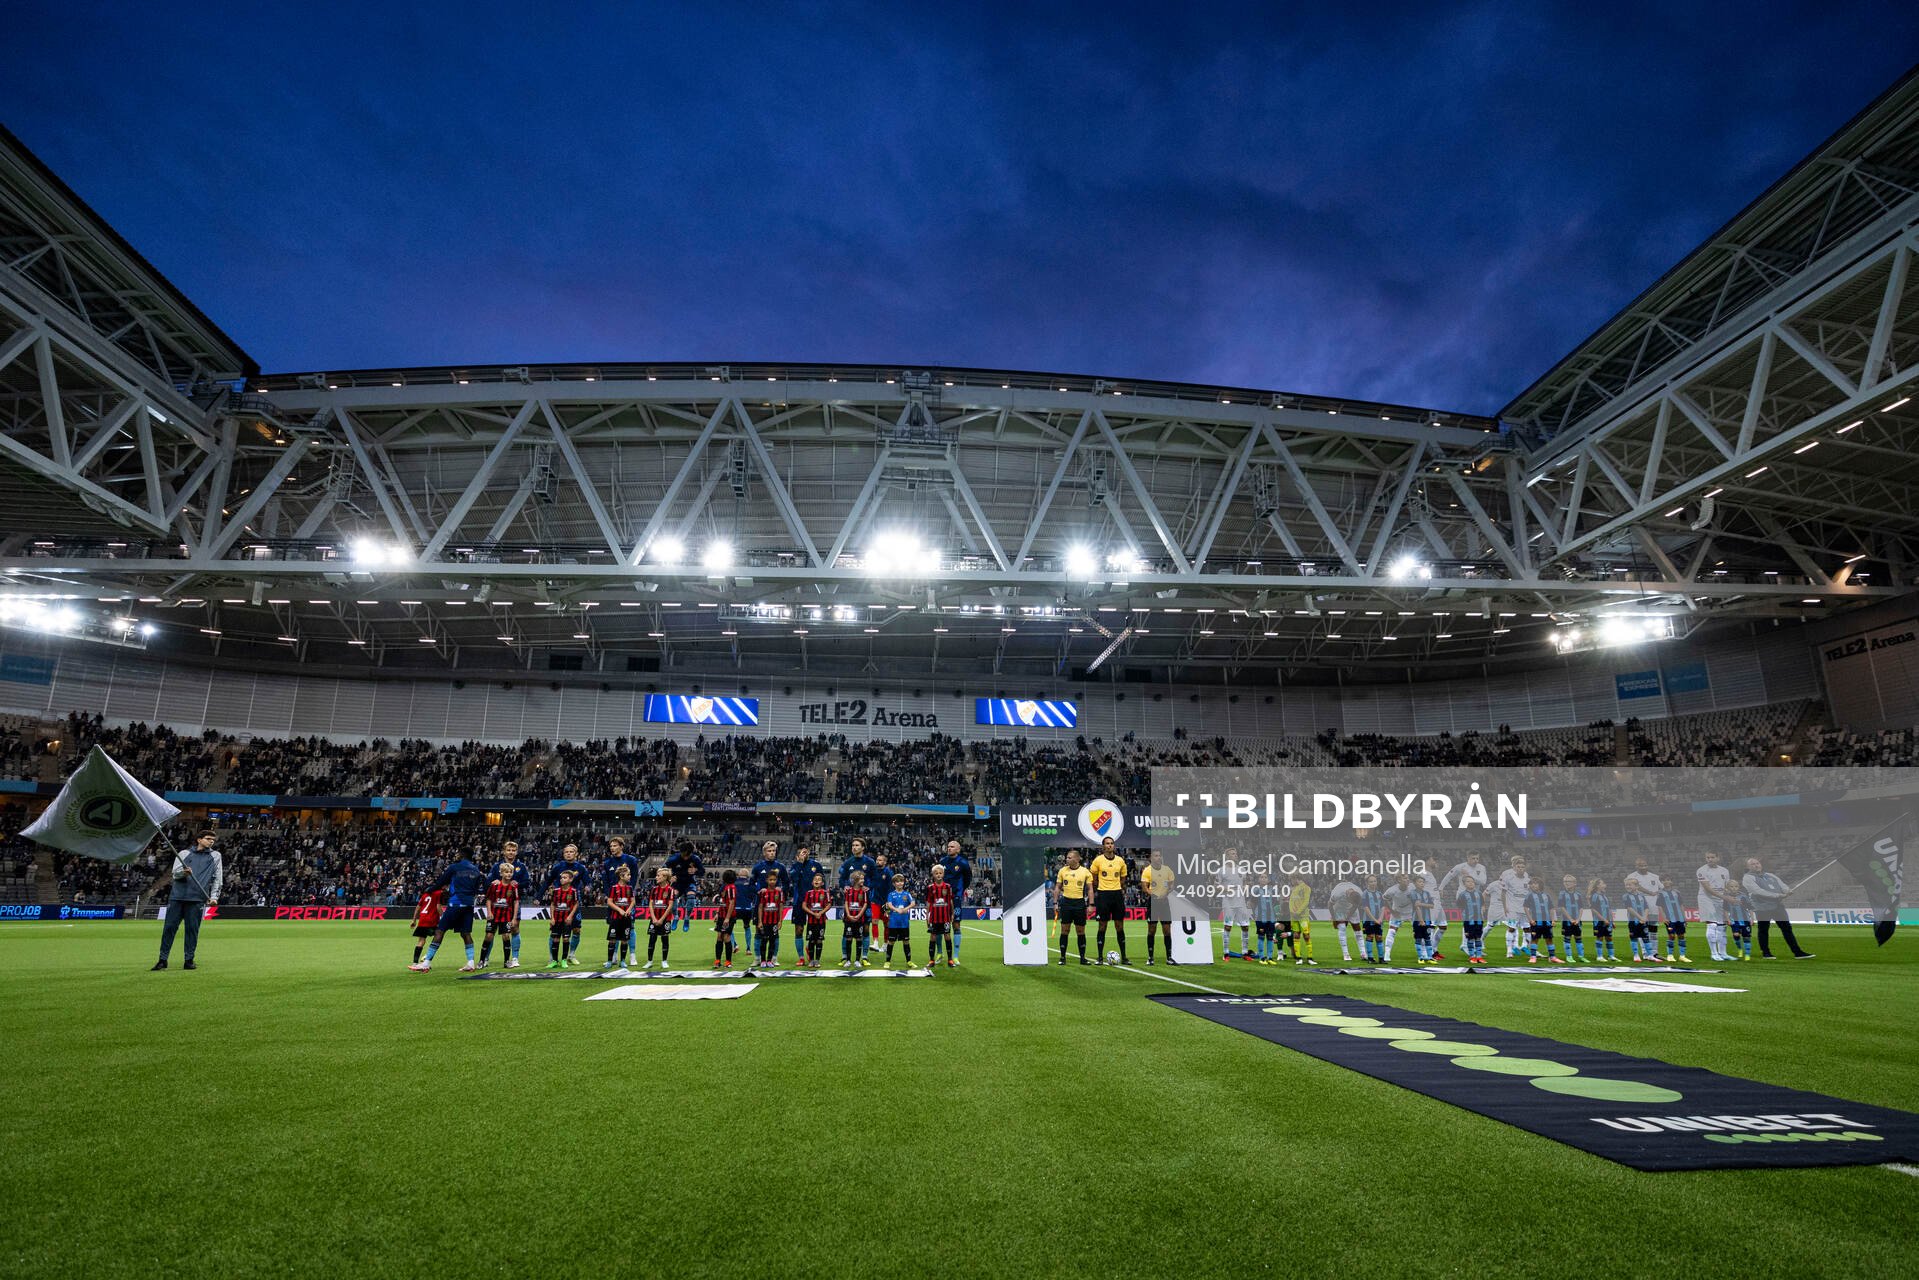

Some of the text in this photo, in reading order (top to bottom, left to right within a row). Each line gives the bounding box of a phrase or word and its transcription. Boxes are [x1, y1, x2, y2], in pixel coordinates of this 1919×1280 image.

[1825, 632, 1916, 661] TELE2 Arena
[799, 700, 938, 728] TELE2 Arena
[1011, 814, 1067, 827] UNIBET
[0, 906, 41, 916] PROJOB
[275, 906, 387, 920] PREDATOR
[421, 896, 432, 914] 2
[1813, 910, 1876, 923] Flinks
[1590, 1113, 1877, 1132] UNIBET
